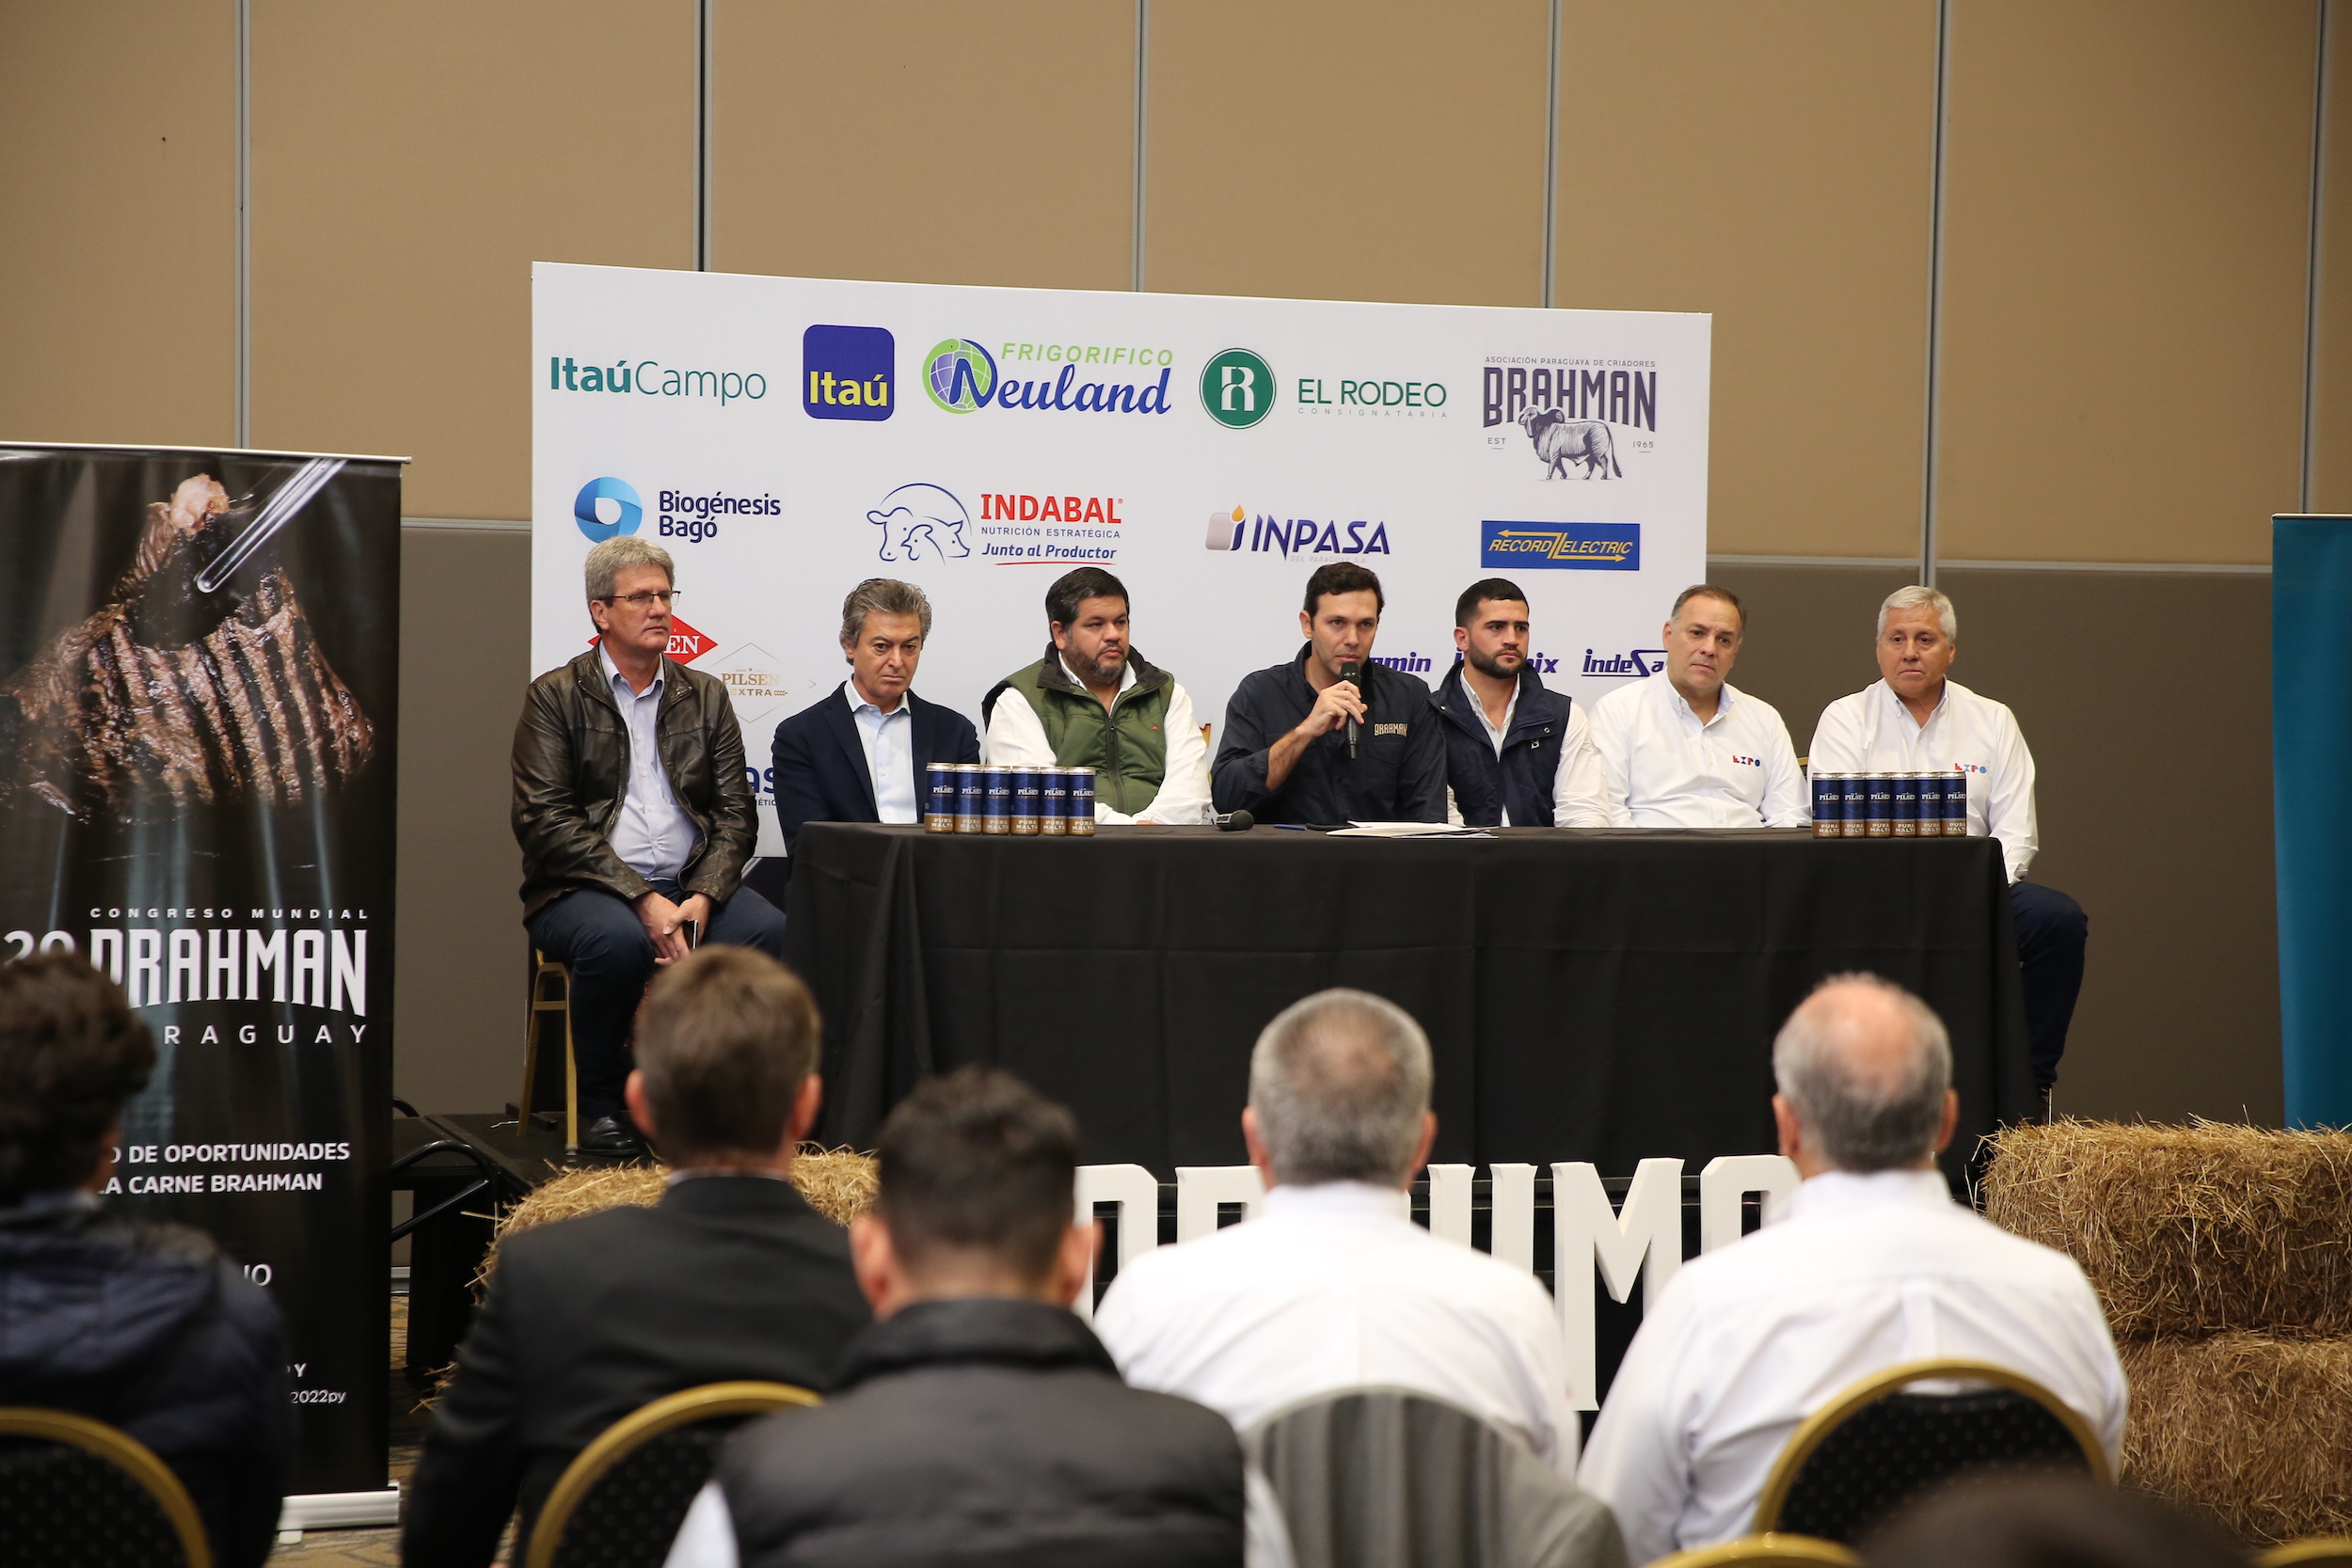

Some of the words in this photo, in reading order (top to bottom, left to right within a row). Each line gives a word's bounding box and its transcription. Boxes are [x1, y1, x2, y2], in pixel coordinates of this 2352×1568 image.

[1001, 342, 1173, 366] FRIGORIFICO
[1607, 359, 1656, 368] CRIADORES
[550, 356, 767, 406] ItaúCampo
[810, 371, 888, 406] Itaú
[948, 357, 1172, 415] Neuland
[1298, 379, 1332, 404] EL
[1341, 380, 1447, 406] RODEO
[1483, 367, 1657, 433] BRAHMAN
[1297, 407, 1447, 419] CONSIGNATARIA
[660, 490, 781, 519] Biogénesis
[660, 515, 717, 543] Bagó
[981, 526, 1041, 536] NUTRICIÓN
[1046, 528, 1120, 539] ESTRATÉGICA
[1251, 515, 1391, 561] INPASA
[981, 543, 1024, 556] Junto
[1027, 545, 1041, 557] al
[1045, 545, 1117, 559] Productor
[1582, 648, 1668, 677] indeSa
[721, 673, 782, 686] PILSEN
[1375, 723, 1408, 736] BRAHMAN
[89, 908, 234, 920] CONGRESO
[251, 908, 368, 920] MUNDIAL
[164, 1024, 367, 1045] RAGUAY
[129, 1145, 158, 1164] DE
[164, 1142, 350, 1163] OPORTUNIDADES
[98, 1176, 122, 1195] A
[128, 1175, 204, 1195] CARNE
[211, 1173, 323, 1193] BRAHMAN
